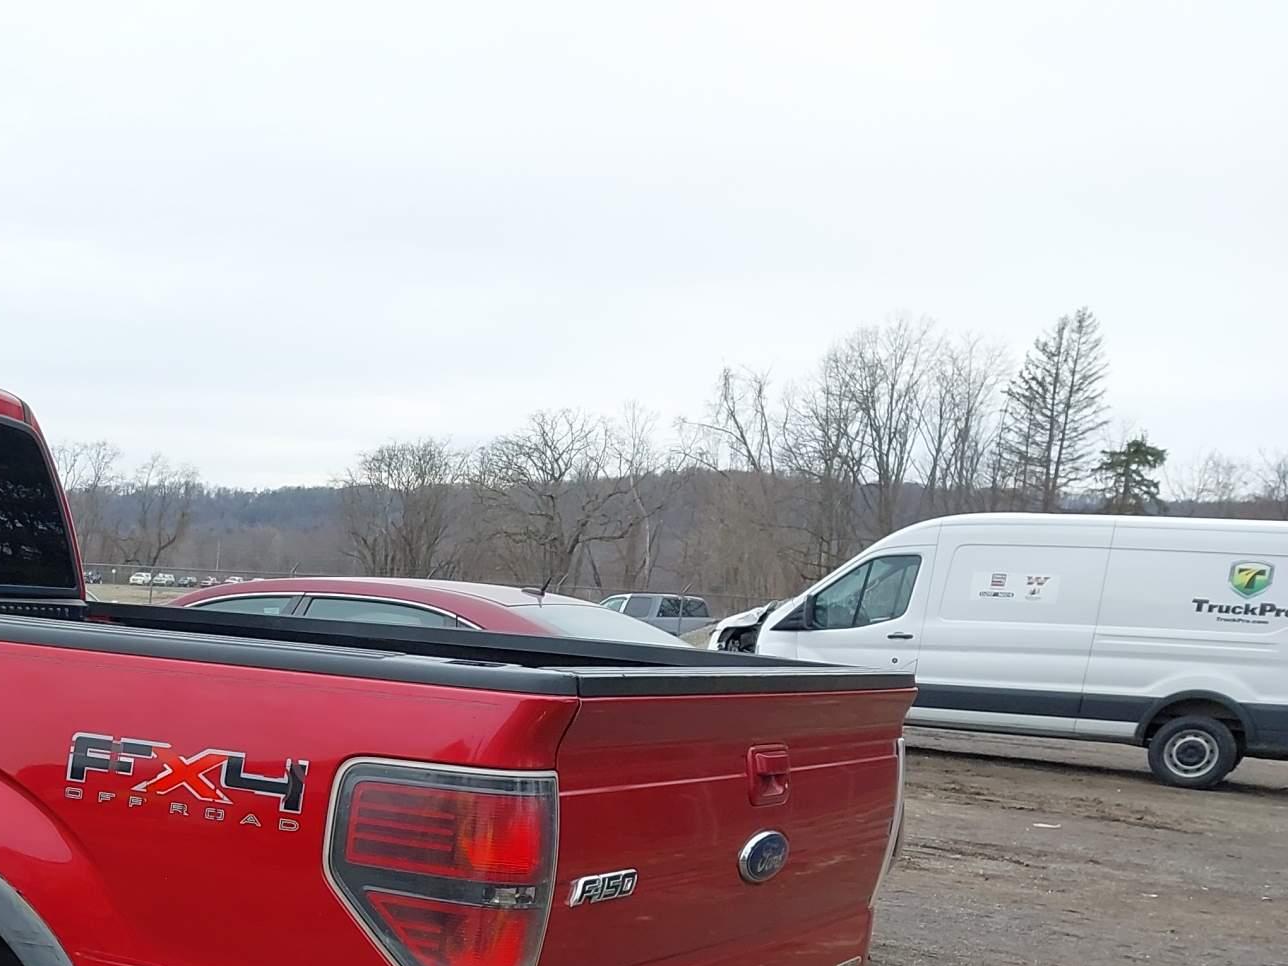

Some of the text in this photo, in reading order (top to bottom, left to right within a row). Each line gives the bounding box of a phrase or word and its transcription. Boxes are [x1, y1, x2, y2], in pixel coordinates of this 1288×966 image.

[1192, 598, 1288, 618] TruckPr
[66, 732, 310, 815] FX4
[65, 786, 300, 832] OFF ROAD
